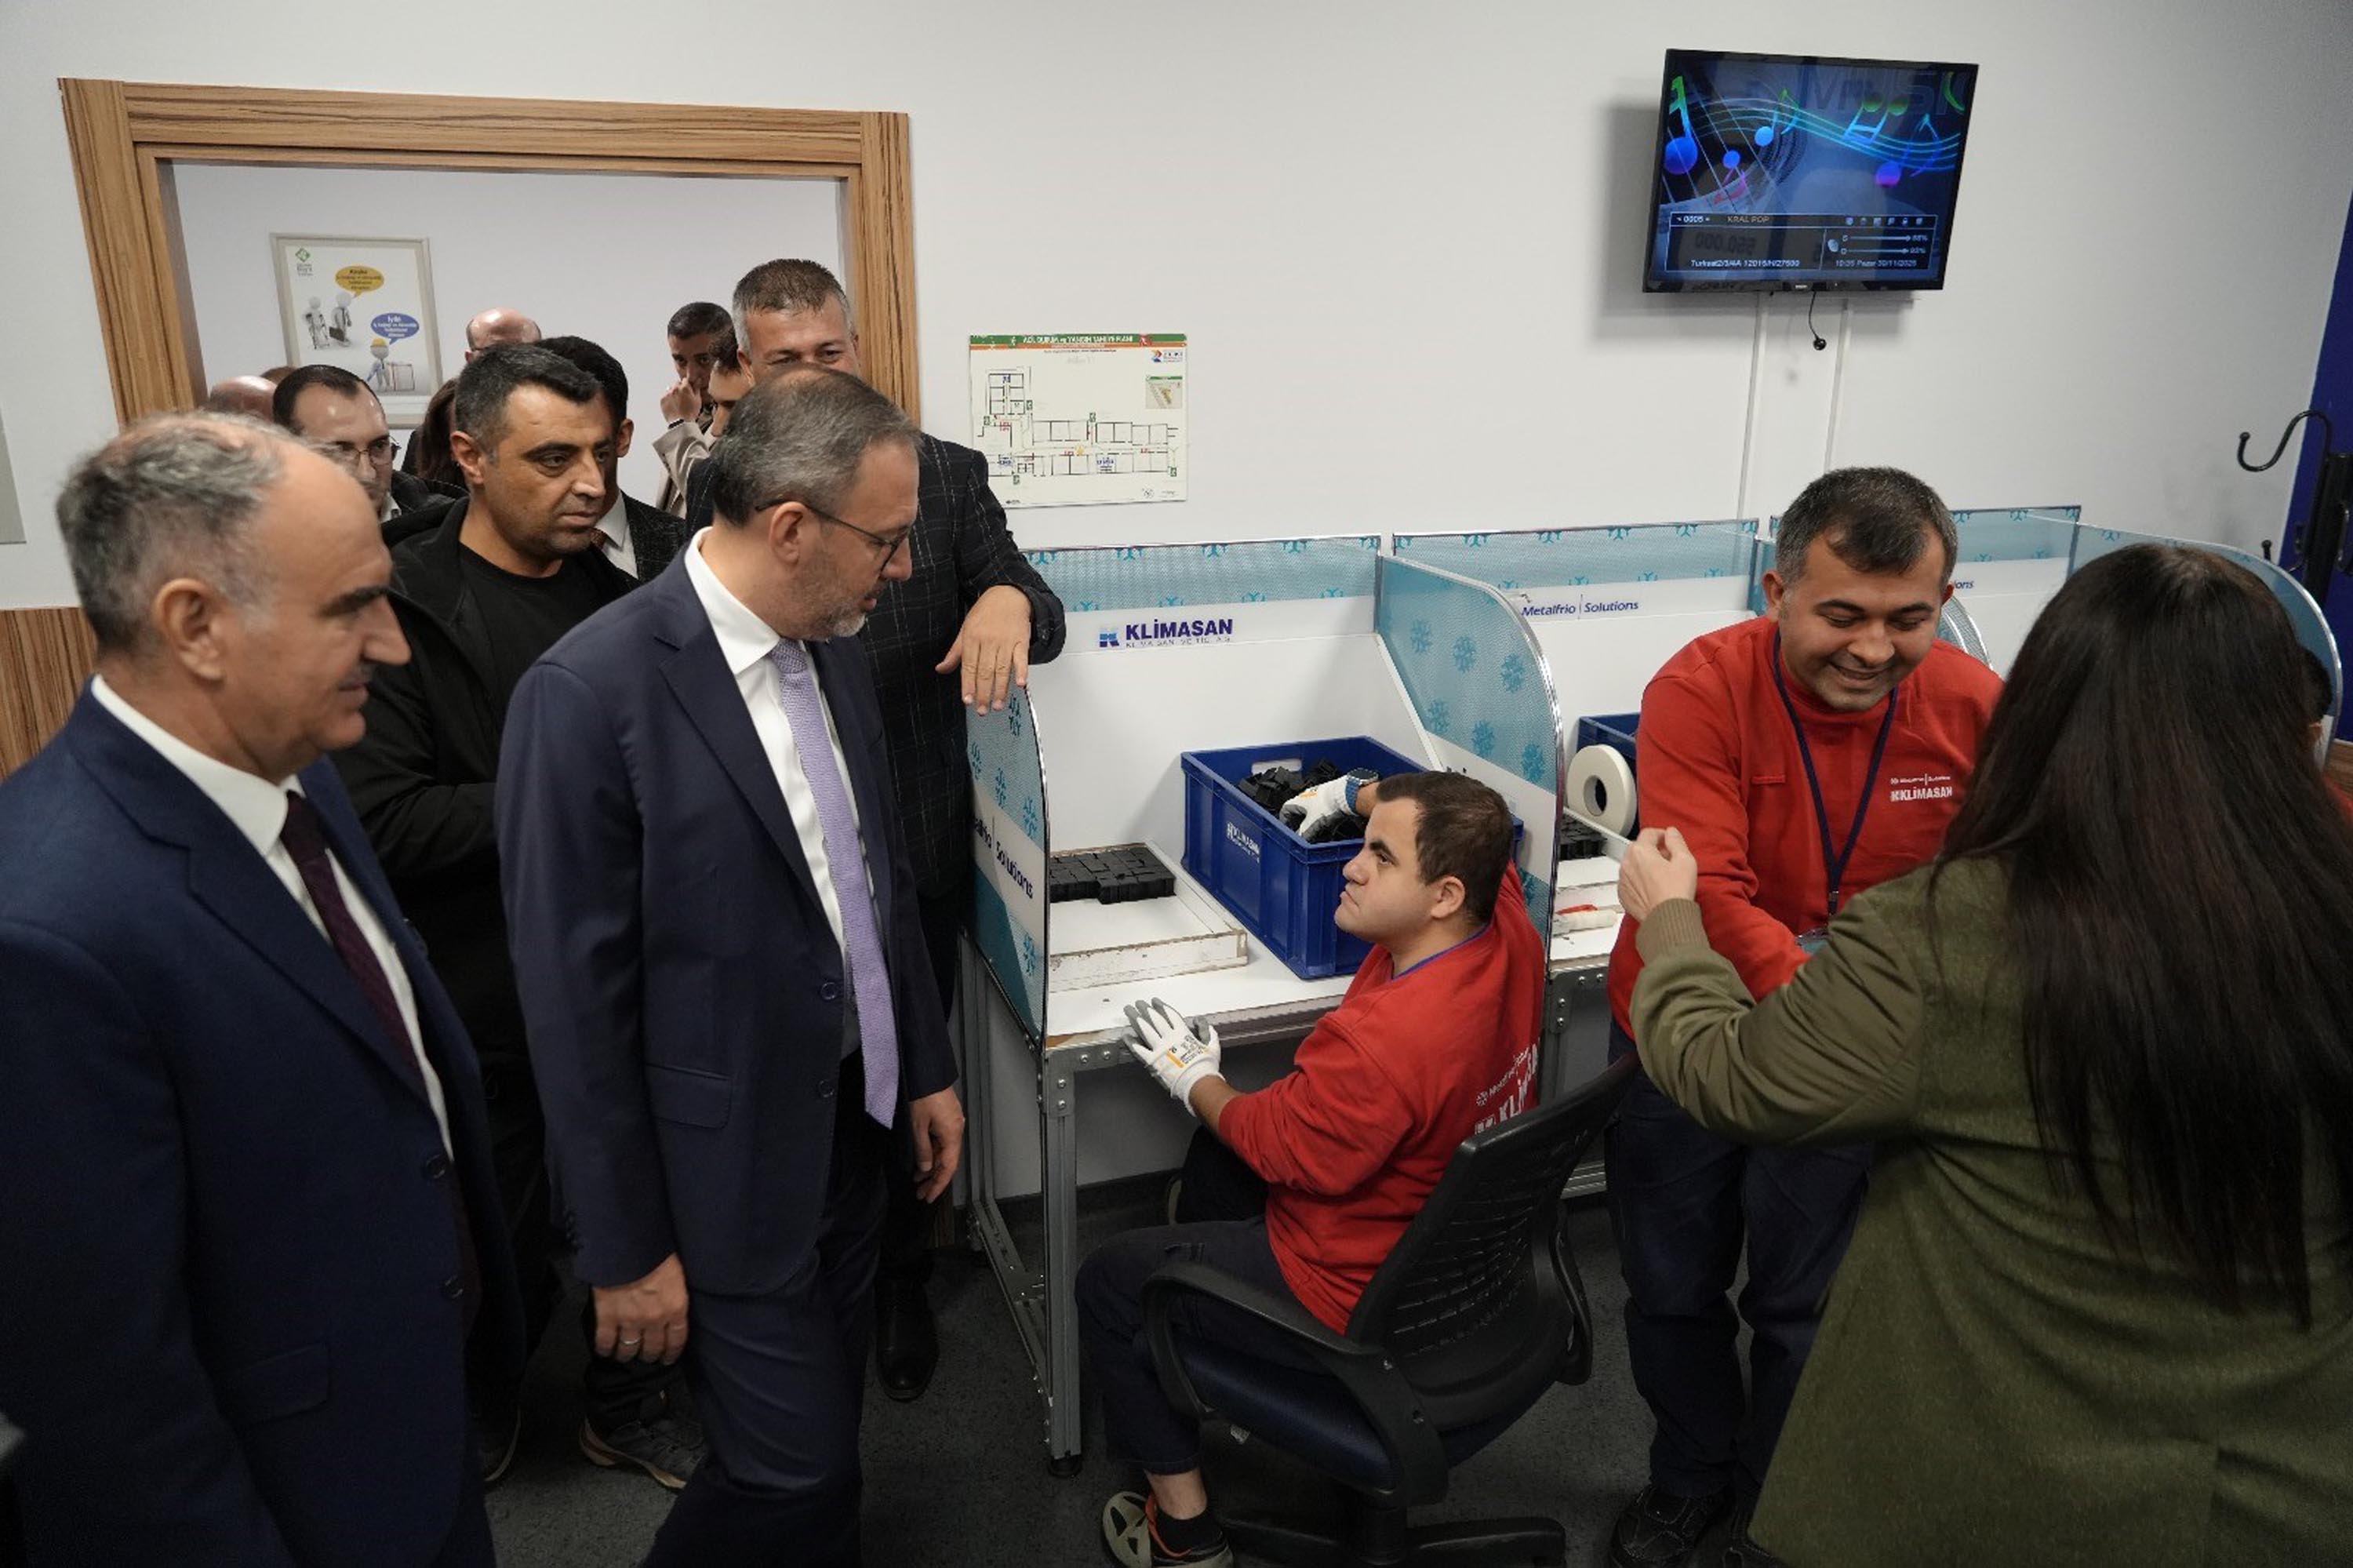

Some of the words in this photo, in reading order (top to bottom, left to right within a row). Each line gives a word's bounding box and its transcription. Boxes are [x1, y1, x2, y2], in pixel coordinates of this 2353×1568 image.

[1521, 603, 1577, 617] Metalfrio
[1584, 601, 1639, 613] Solutions
[1126, 618, 1233, 640] KLİMASAN
